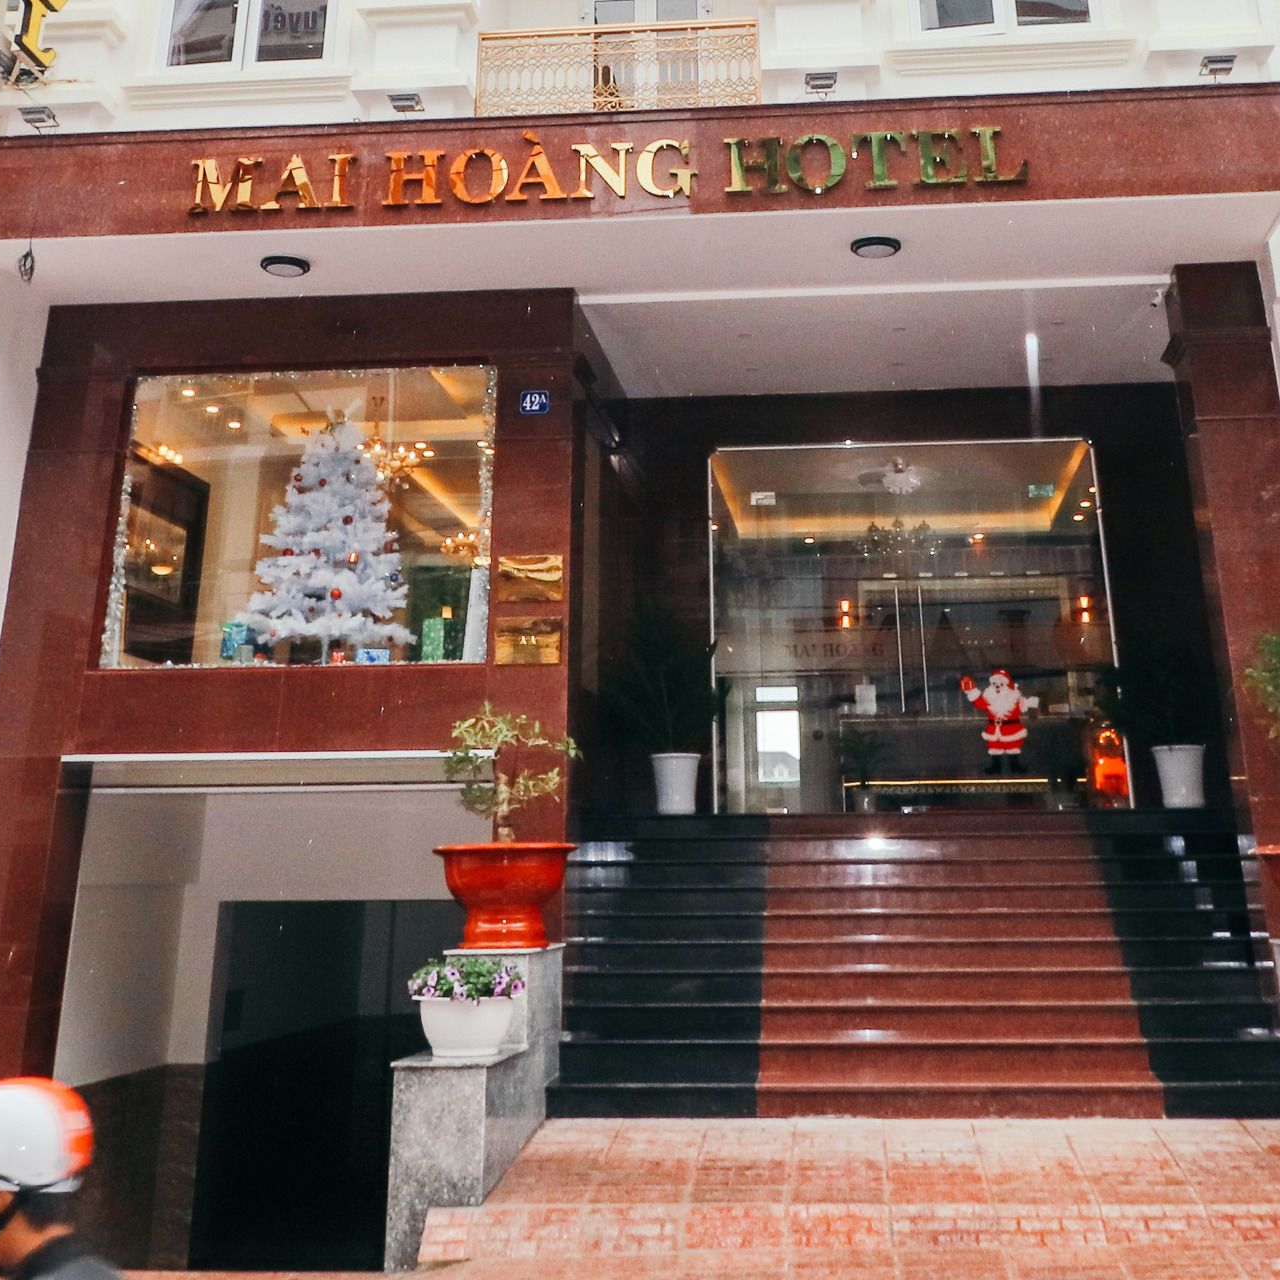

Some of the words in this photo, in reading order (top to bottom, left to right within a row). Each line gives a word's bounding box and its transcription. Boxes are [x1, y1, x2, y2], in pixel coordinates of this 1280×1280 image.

[189, 151, 356, 212] MAI
[379, 131, 699, 206] HOÀNG
[722, 124, 1030, 195] HOTEL
[522, 394, 547, 411] 42A
